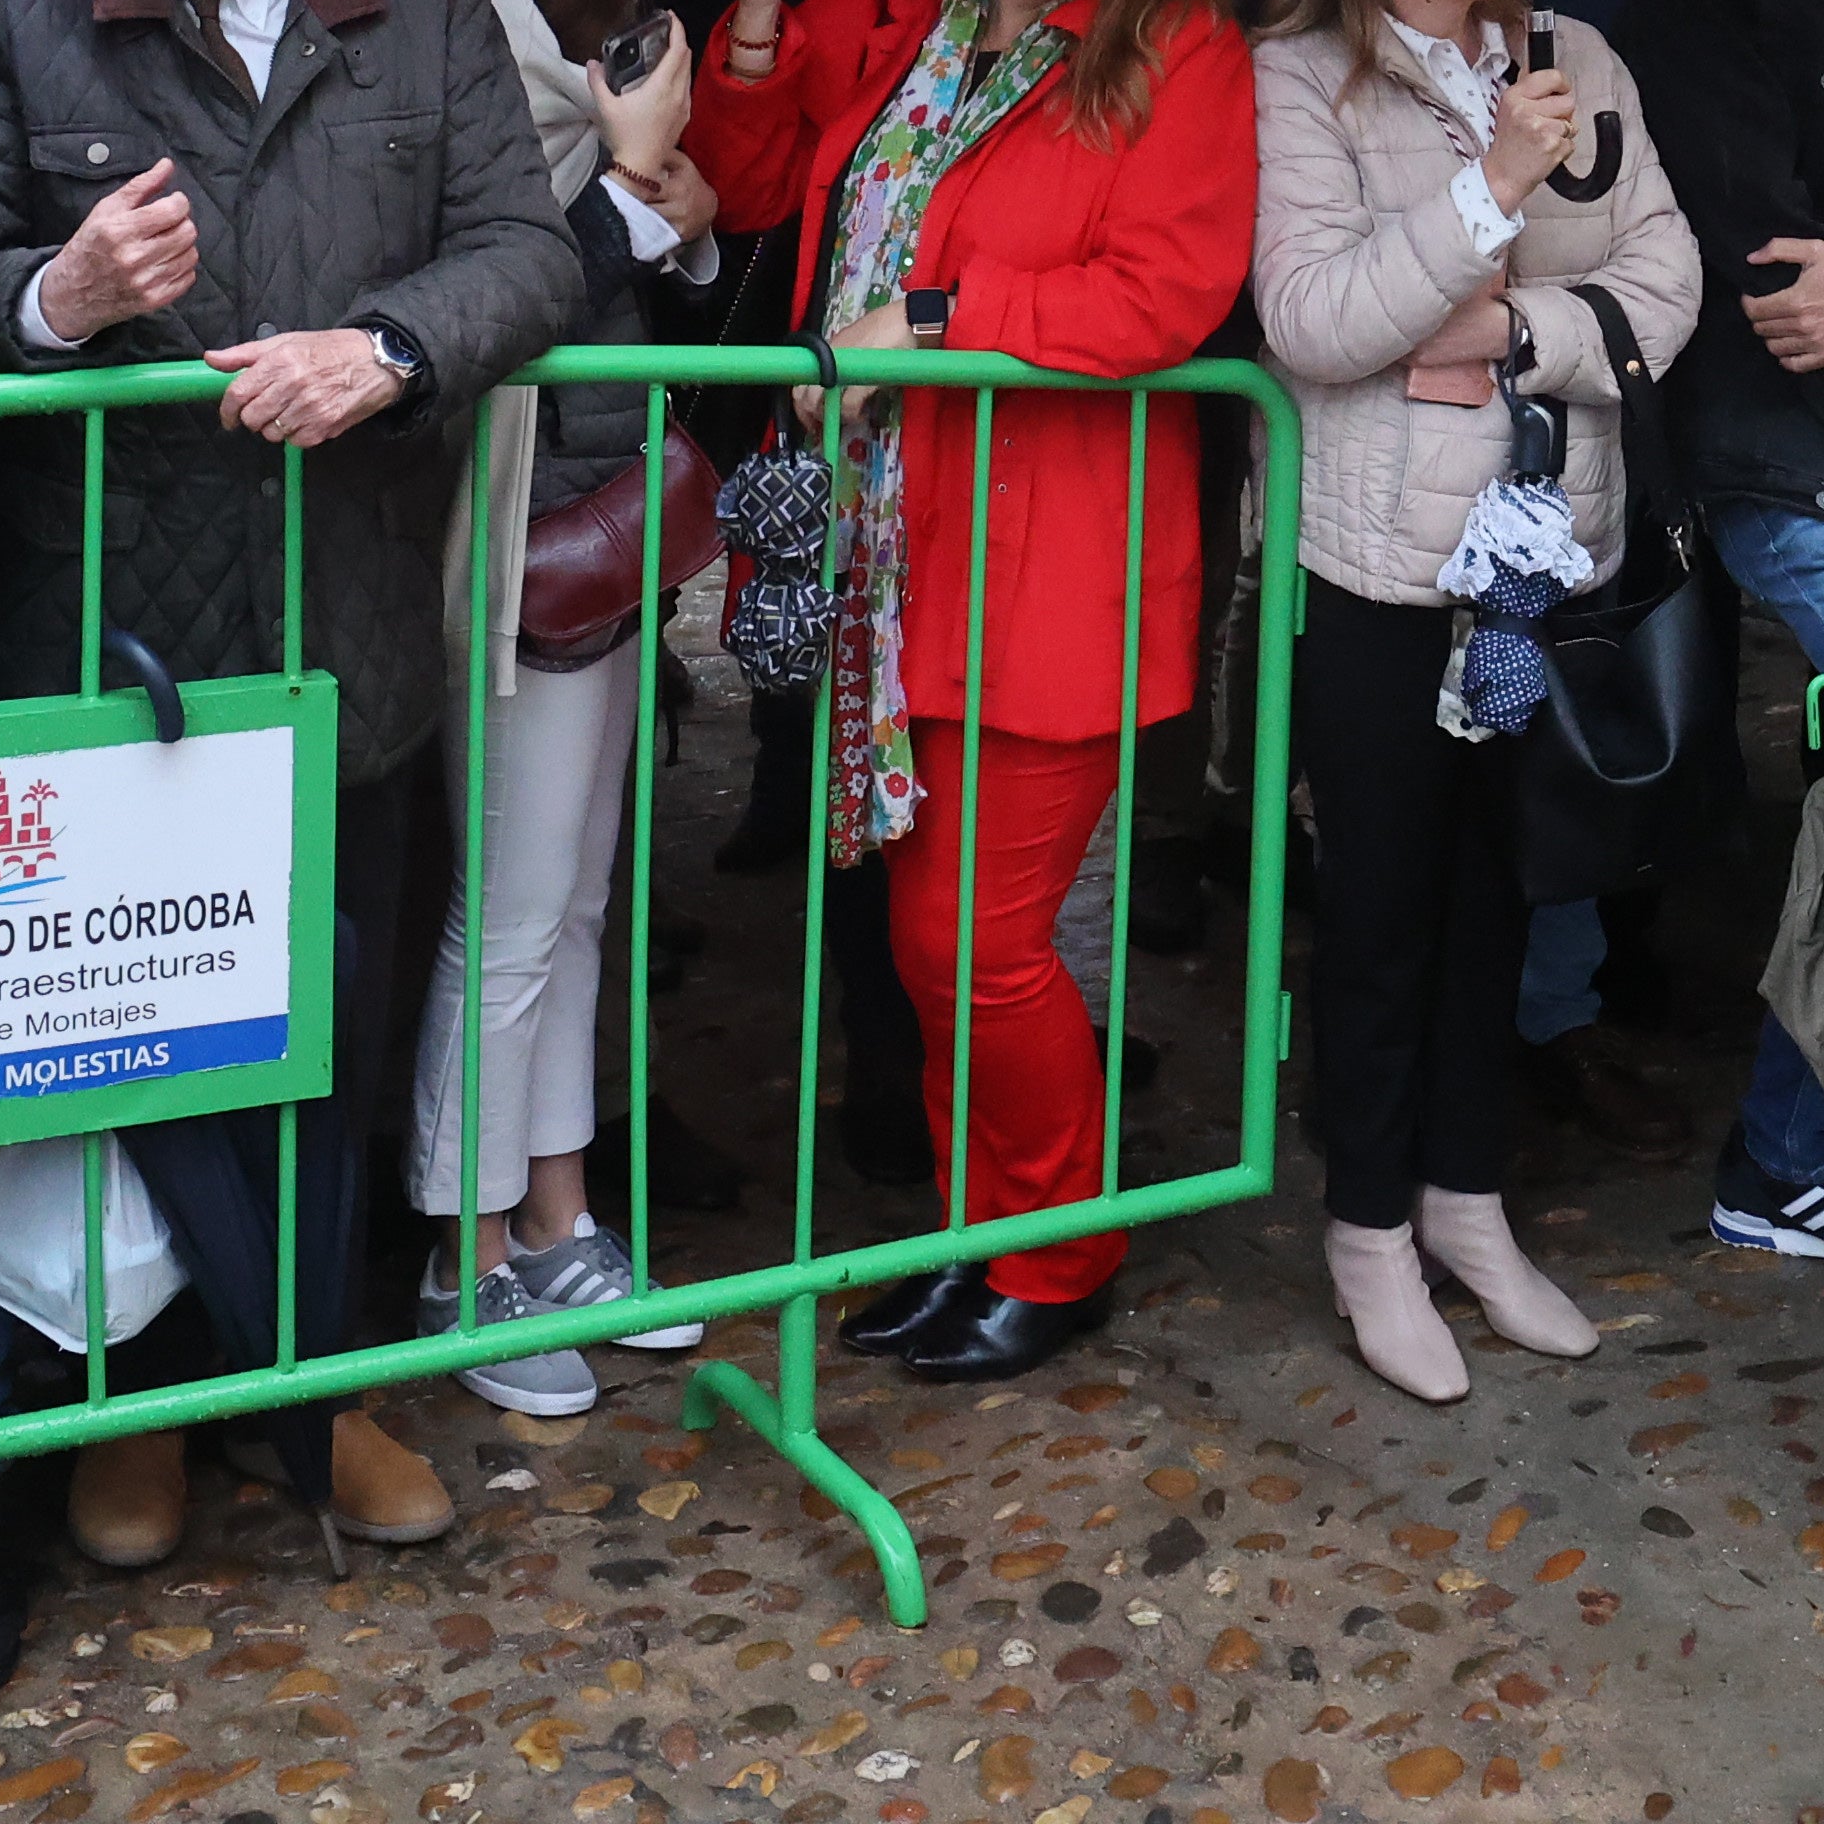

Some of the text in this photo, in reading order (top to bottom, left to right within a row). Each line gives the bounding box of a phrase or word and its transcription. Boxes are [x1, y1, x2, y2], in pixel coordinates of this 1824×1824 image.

[28, 911, 72, 953] DE
[84, 889, 255, 946] CÓRDOBA
[26, 1001, 157, 1035] Montajes
[5, 1042, 170, 1090] MOLESTIAS
